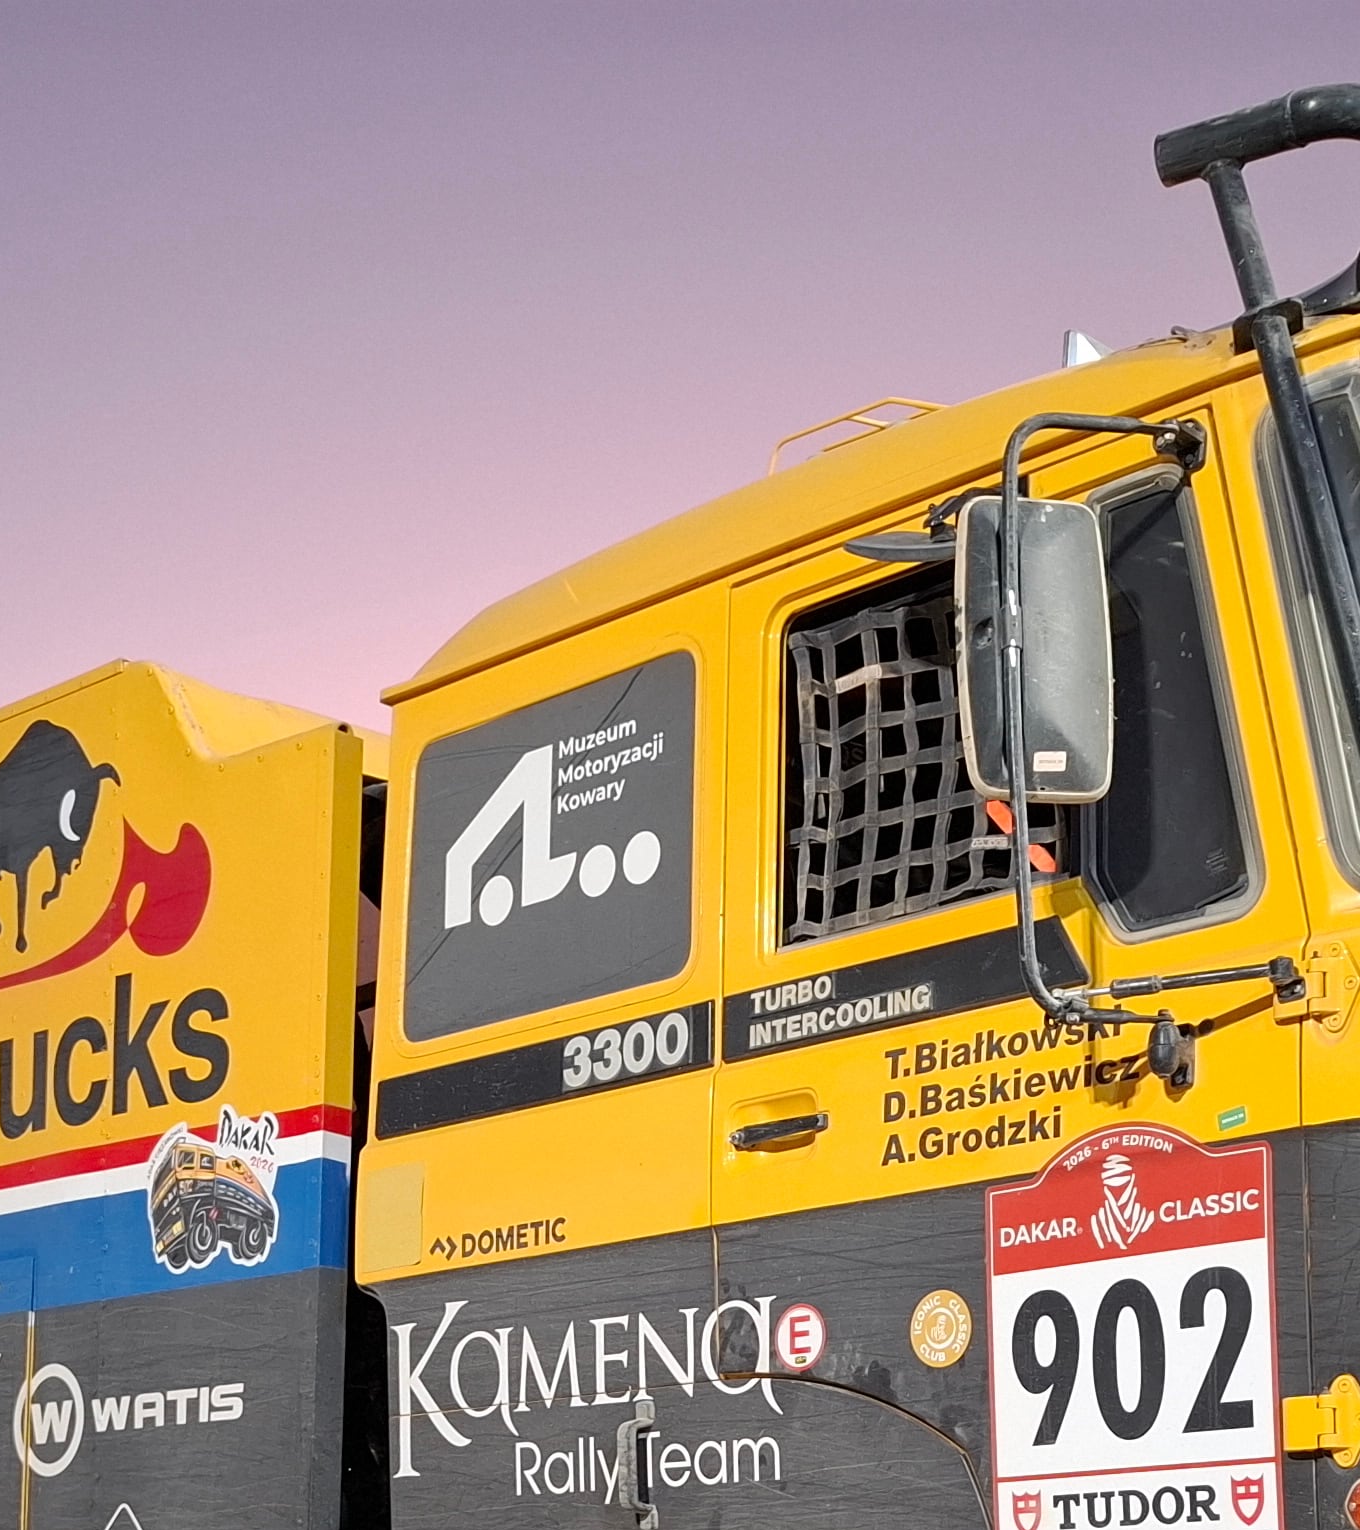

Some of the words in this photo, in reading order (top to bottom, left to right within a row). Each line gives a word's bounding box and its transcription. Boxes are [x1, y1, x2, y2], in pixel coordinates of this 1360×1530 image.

[557, 733, 664, 786] Motoryzacji
[558, 717, 638, 759] Muzeum
[557, 777, 626, 815] Kowary
[749, 984, 932, 1049] INTERCOOLING
[750, 974, 832, 1015] TURBO
[562, 1012, 689, 1089] 3300
[883, 1053, 1141, 1123] D.Baśkiewicz
[219, 1109, 275, 1156] DAKAR
[881, 1106, 1062, 1166] A.Grodzki
[1062, 1146, 1092, 1171] 2026
[1122, 1134, 1173, 1154] EDITION
[1158, 1189, 1260, 1222] CLASSIC
[462, 1217, 567, 1259] DOMETIC
[999, 1218, 1078, 1248] DAKAR
[789, 1314, 812, 1355] E
[913, 1296, 941, 1335] ICONIC
[948, 1298, 968, 1354] CLASSIC
[919, 1343, 946, 1362] CLUB
[1011, 1266, 1255, 1447] 902
[92, 1383, 244, 1433] WATIS
[515, 1436, 619, 1505] Rally
[637, 1431, 781, 1488] Team
[1052, 1484, 1220, 1530] TUDOR
